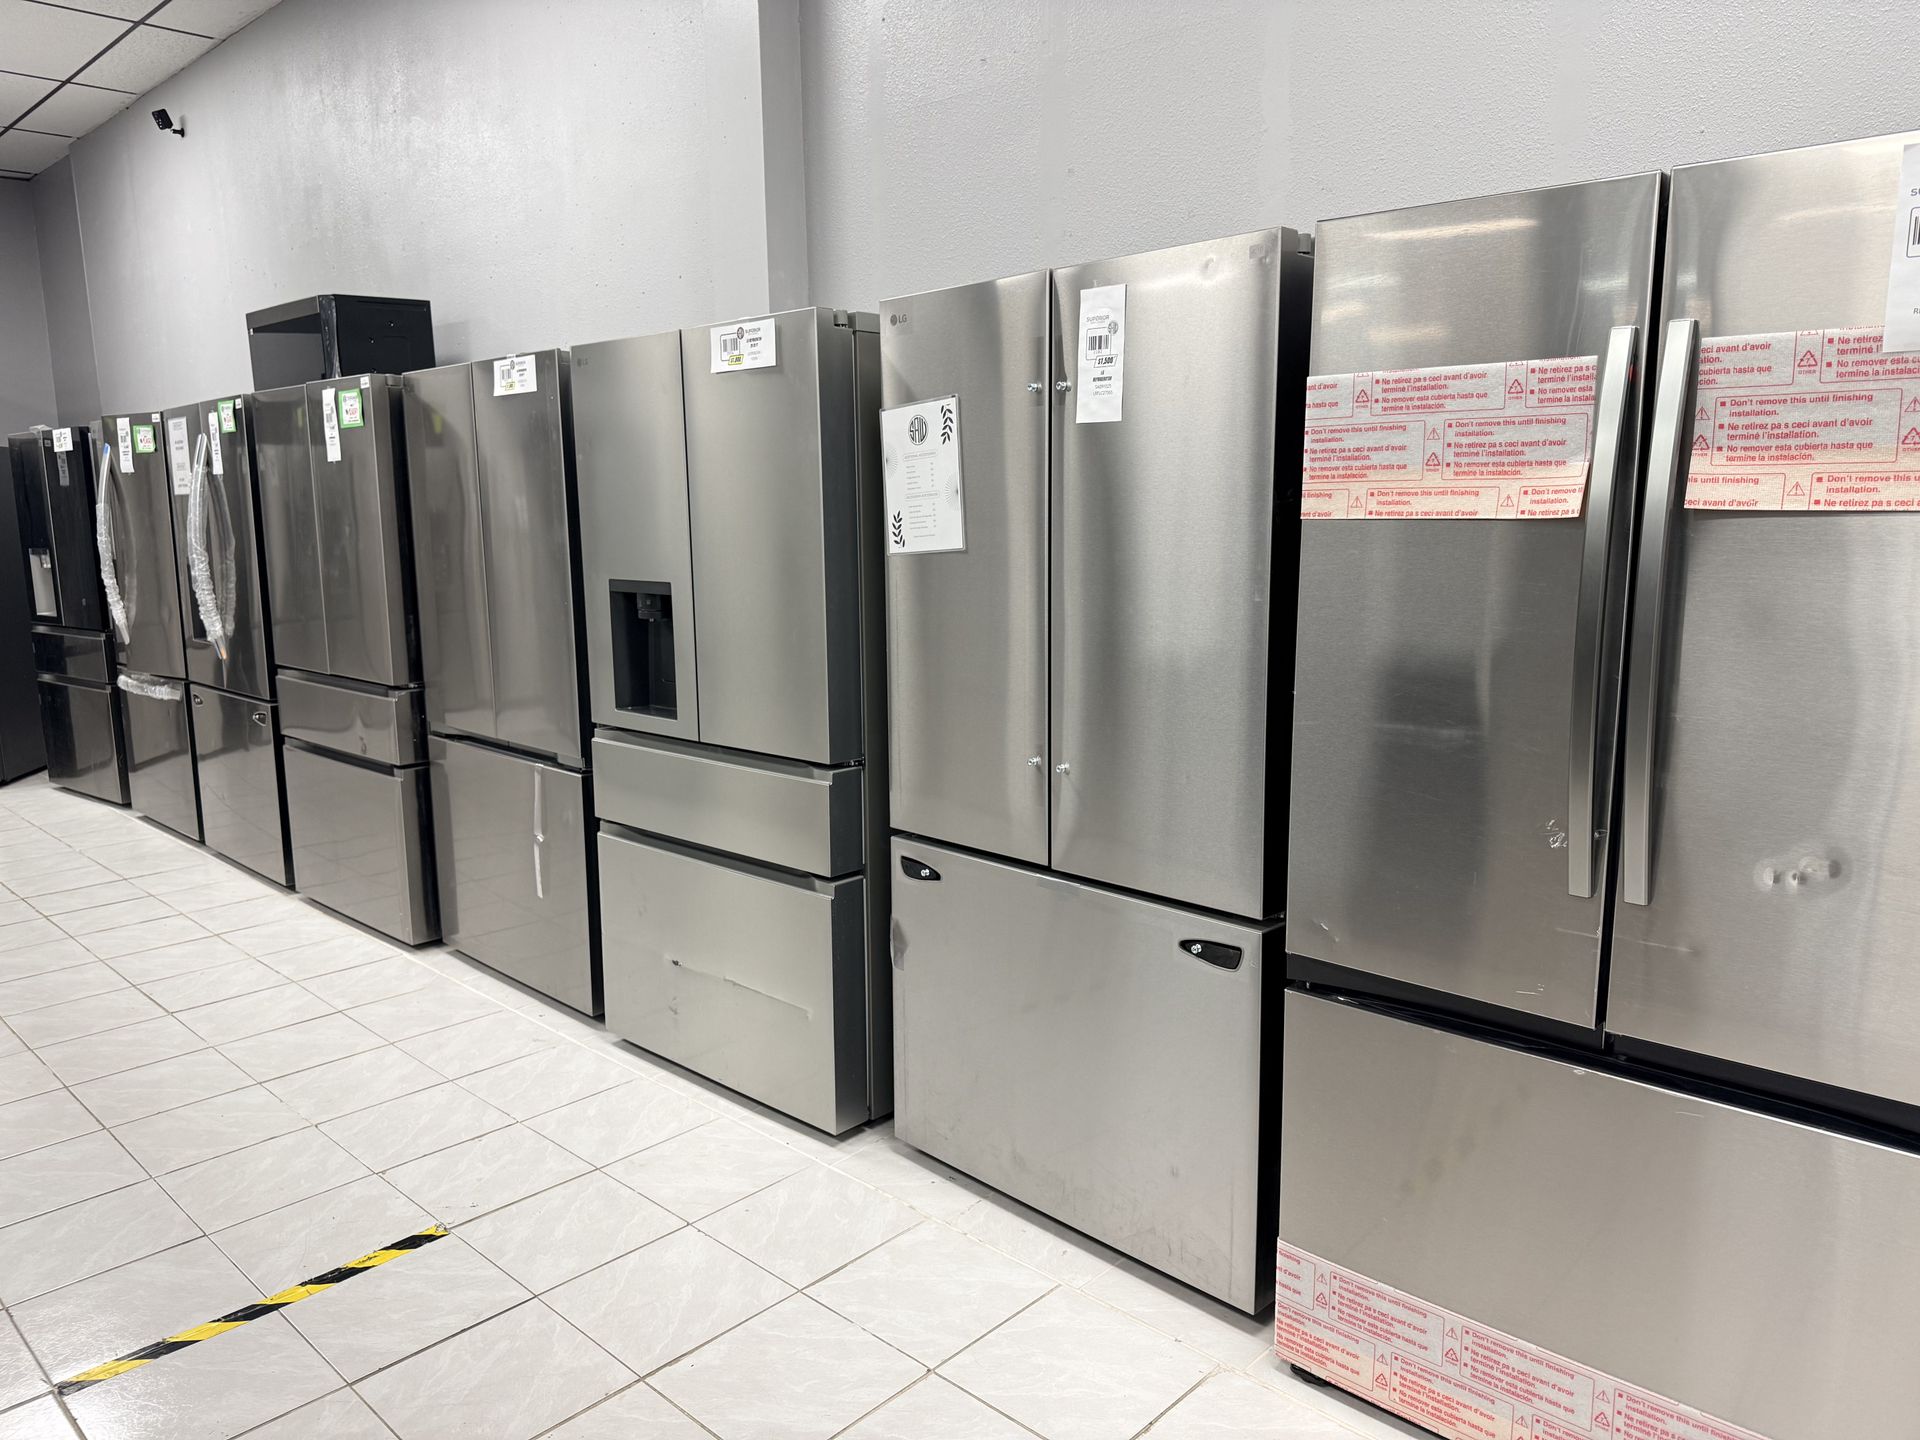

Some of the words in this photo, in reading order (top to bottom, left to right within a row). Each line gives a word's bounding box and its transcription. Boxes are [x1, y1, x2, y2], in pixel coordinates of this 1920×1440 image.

[898, 314, 907, 323] LG
[1838, 336, 1850, 344] Ne
[1853, 334, 1883, 343] retirez
[1701, 345, 1713, 353] eci
[1837, 359, 1848, 367] No
[1852, 358, 1888, 366] remover
[1891, 356, 1910, 364] esta
[1733, 365, 1754, 373] hasta
[1757, 366, 1771, 374] que
[1730, 398, 1753, 406] Don't
[1791, 396, 1806, 404] this
[1810, 395, 1829, 403] until
[1833, 393, 1873, 404] finishing
[1730, 408, 1779, 416] installation.
[1456, 420, 1473, 428] Don't
[1535, 417, 1566, 426] finishing
[1728, 422, 1739, 430] Ne
[1742, 421, 1768, 429] retirez
[1771, 422, 1781, 430] pa
[1792, 420, 1809, 428] ceci
[1812, 419, 1837, 427] avant
[1840, 418, 1872, 427] d'avoir
[1763, 430, 1819, 439] l'installation.
[1454, 441, 1463, 449] Ne
[1520, 439, 1539, 447] avant
[1727, 444, 1738, 452] No
[1775, 443, 1792, 451] esta
[1794, 442, 1828, 450] cubierta
[1830, 441, 1854, 449] hasta
[1726, 454, 1756, 462] termine
[1759, 453, 1765, 461] la
[1768, 453, 1814, 461] instalación.
[1506, 459, 1532, 467] cubierta
[1486, 468, 1522, 476] instalación.
[1450, 489, 1479, 497] finishing
[1532, 487, 1550, 495] Don't
[1826, 485, 1880, 493] installation.
[1376, 498, 1412, 506] installation.
[1872, 500, 1883, 508] pa
